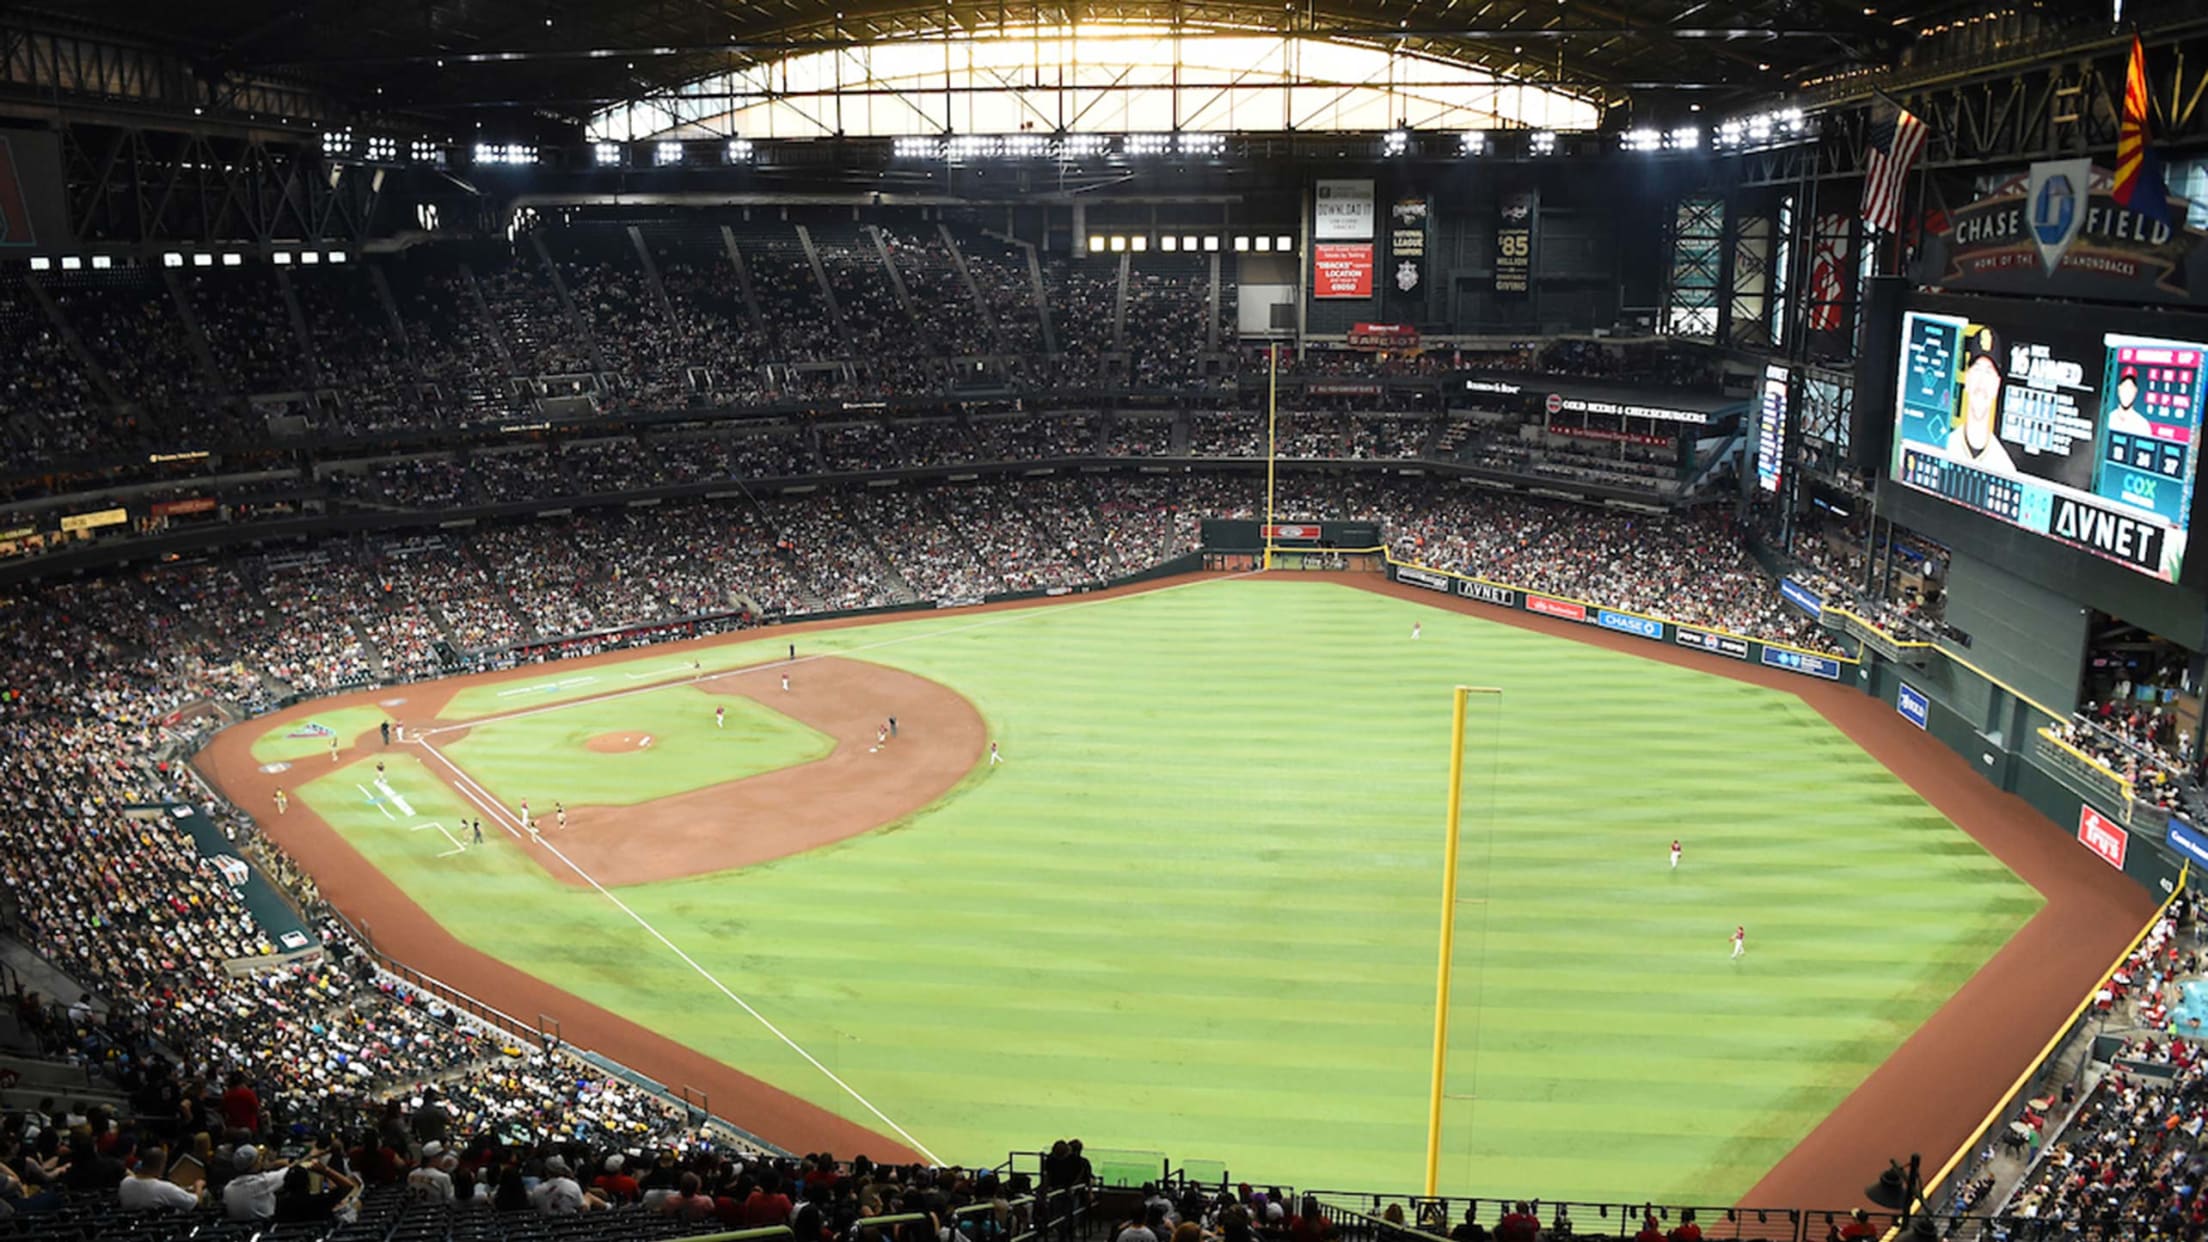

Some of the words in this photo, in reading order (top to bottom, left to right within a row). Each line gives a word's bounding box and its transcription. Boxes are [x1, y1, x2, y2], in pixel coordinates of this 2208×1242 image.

[1956, 210, 2020, 244] CHASE
[2087, 208, 2171, 245] FIELD
[1393, 238, 1424, 247] LEAGUE
[2001, 255, 2014, 267] OF
[2017, 254, 2033, 266] THE
[2063, 255, 2135, 276] DIAMONDBACKS
[2123, 473, 2157, 498] COX
[2056, 500, 2154, 562] AVNET
[1464, 582, 1508, 602] AVNET
[1606, 614, 1643, 631] CHASE
